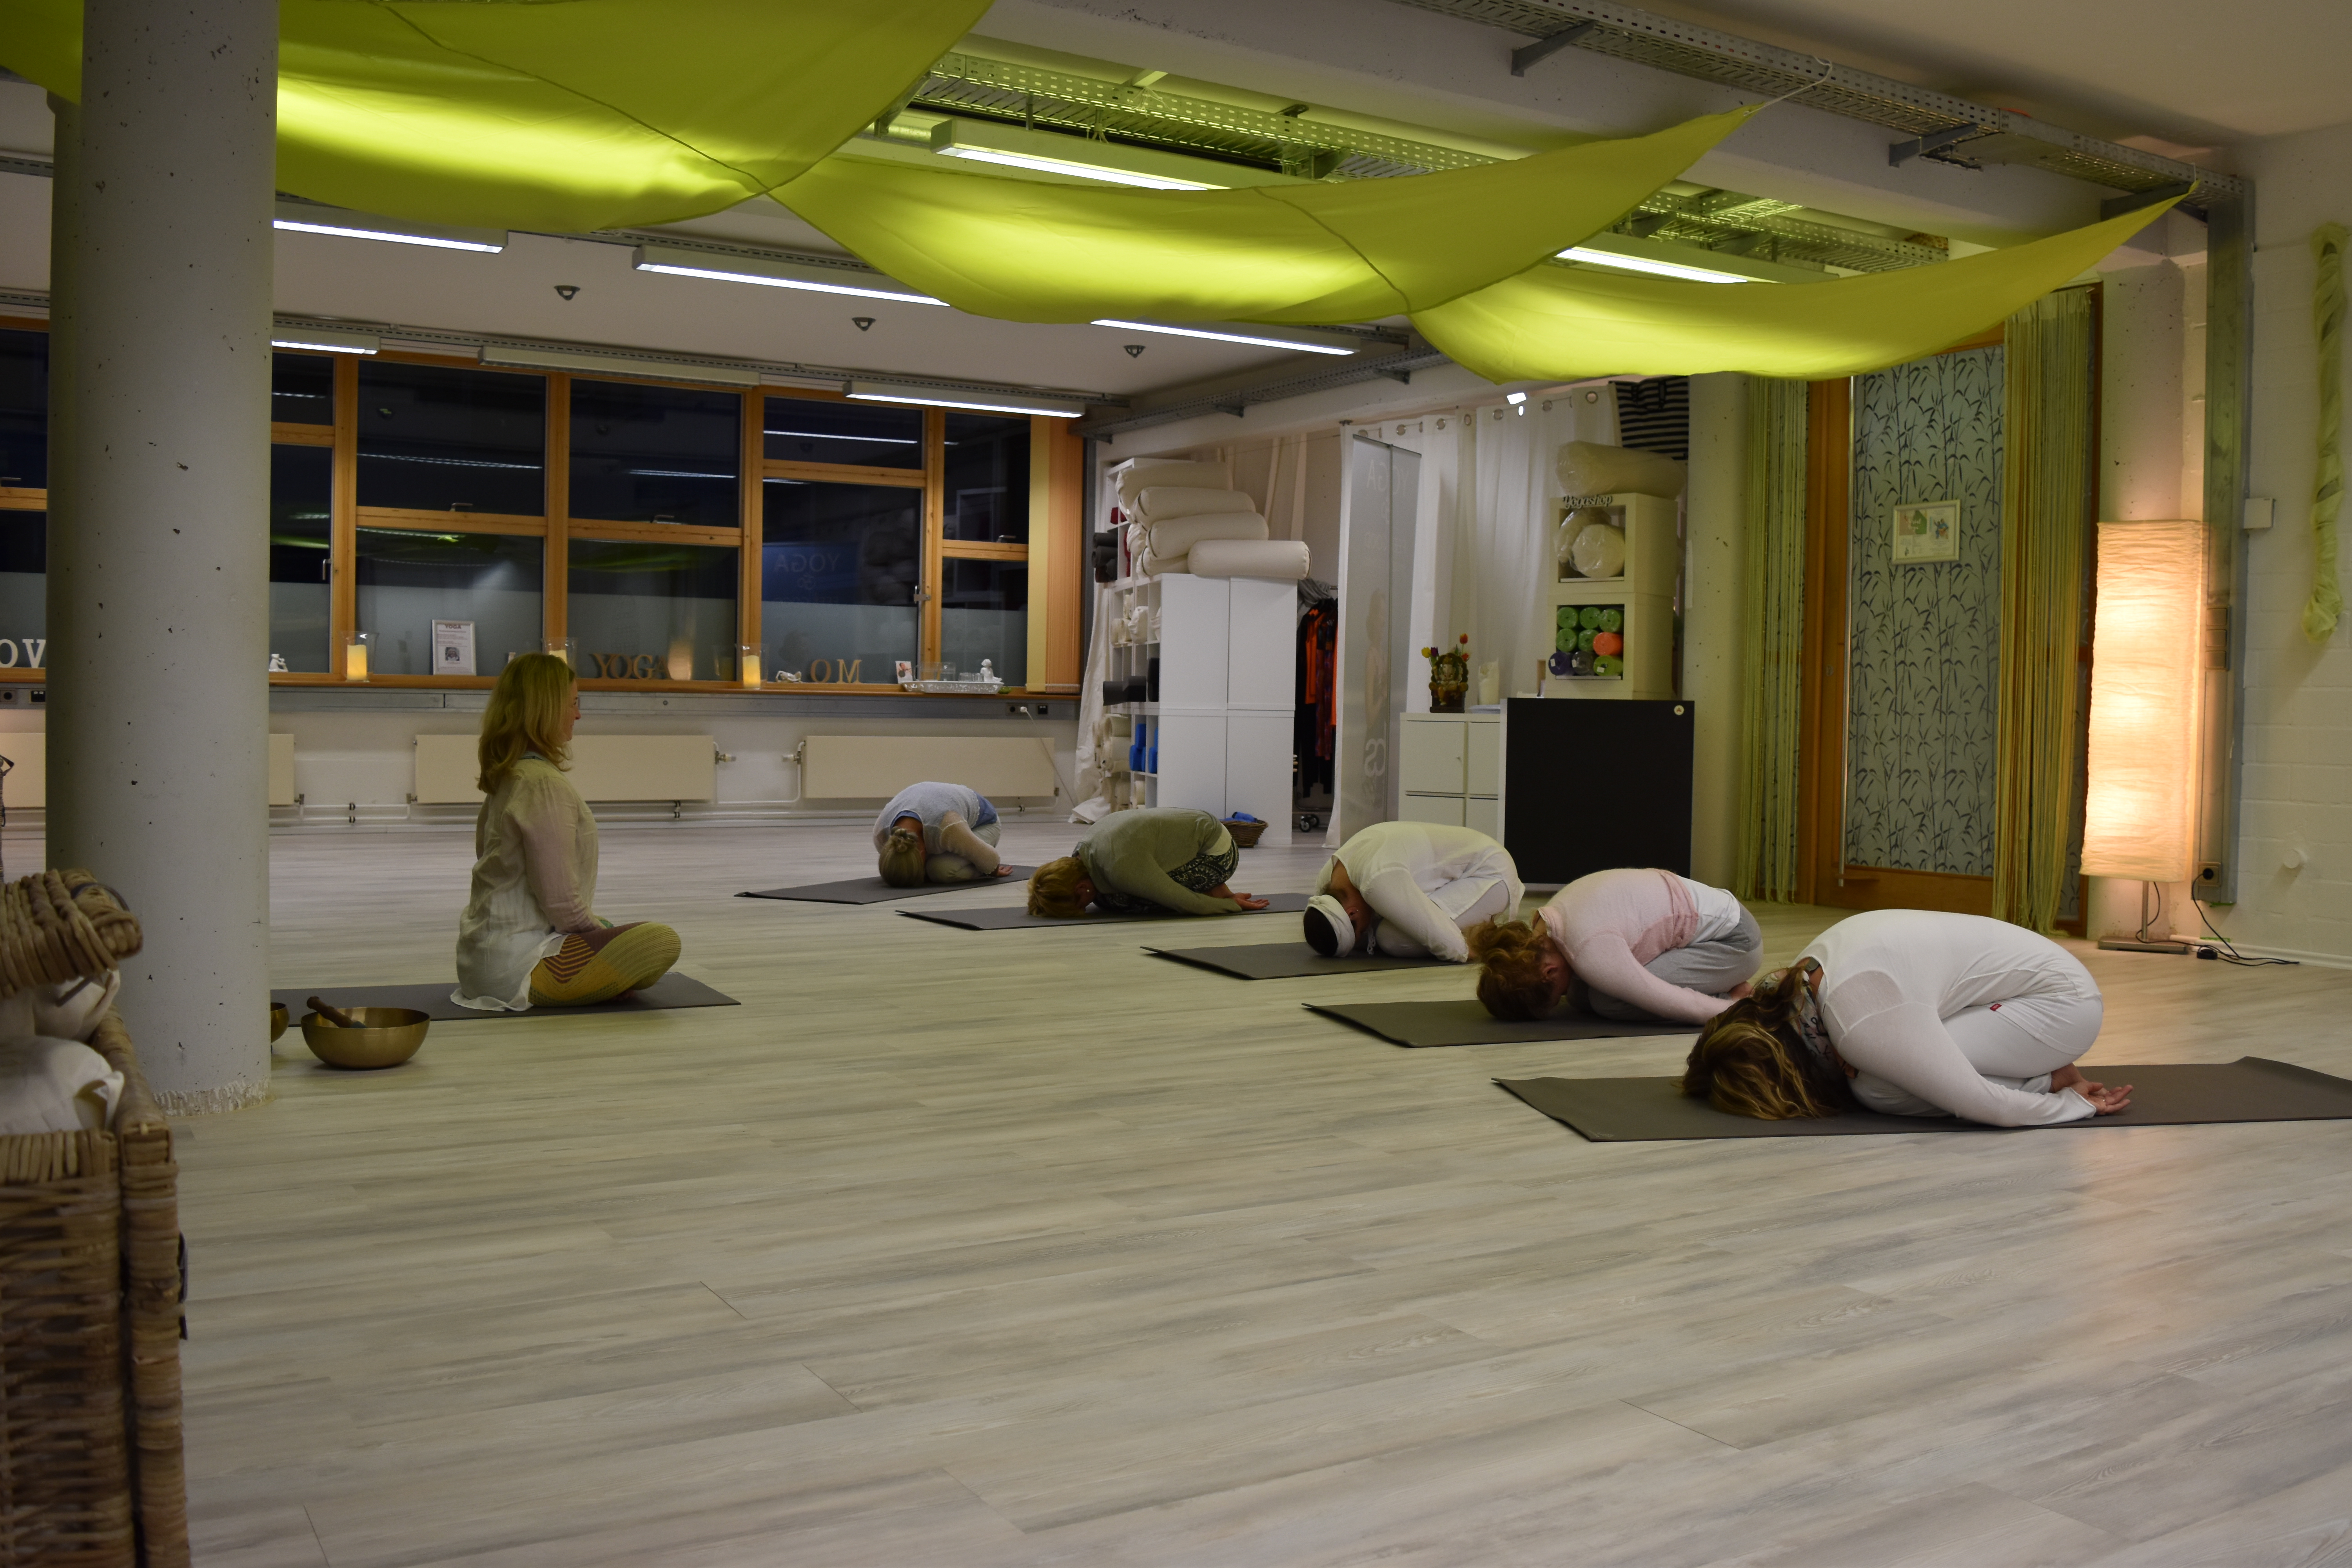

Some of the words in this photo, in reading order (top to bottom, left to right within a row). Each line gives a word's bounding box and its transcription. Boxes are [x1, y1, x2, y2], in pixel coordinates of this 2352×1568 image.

[1563, 495, 1613, 509] Yogashop
[592, 653, 672, 680] YOGA
[810, 659, 862, 683] OM
